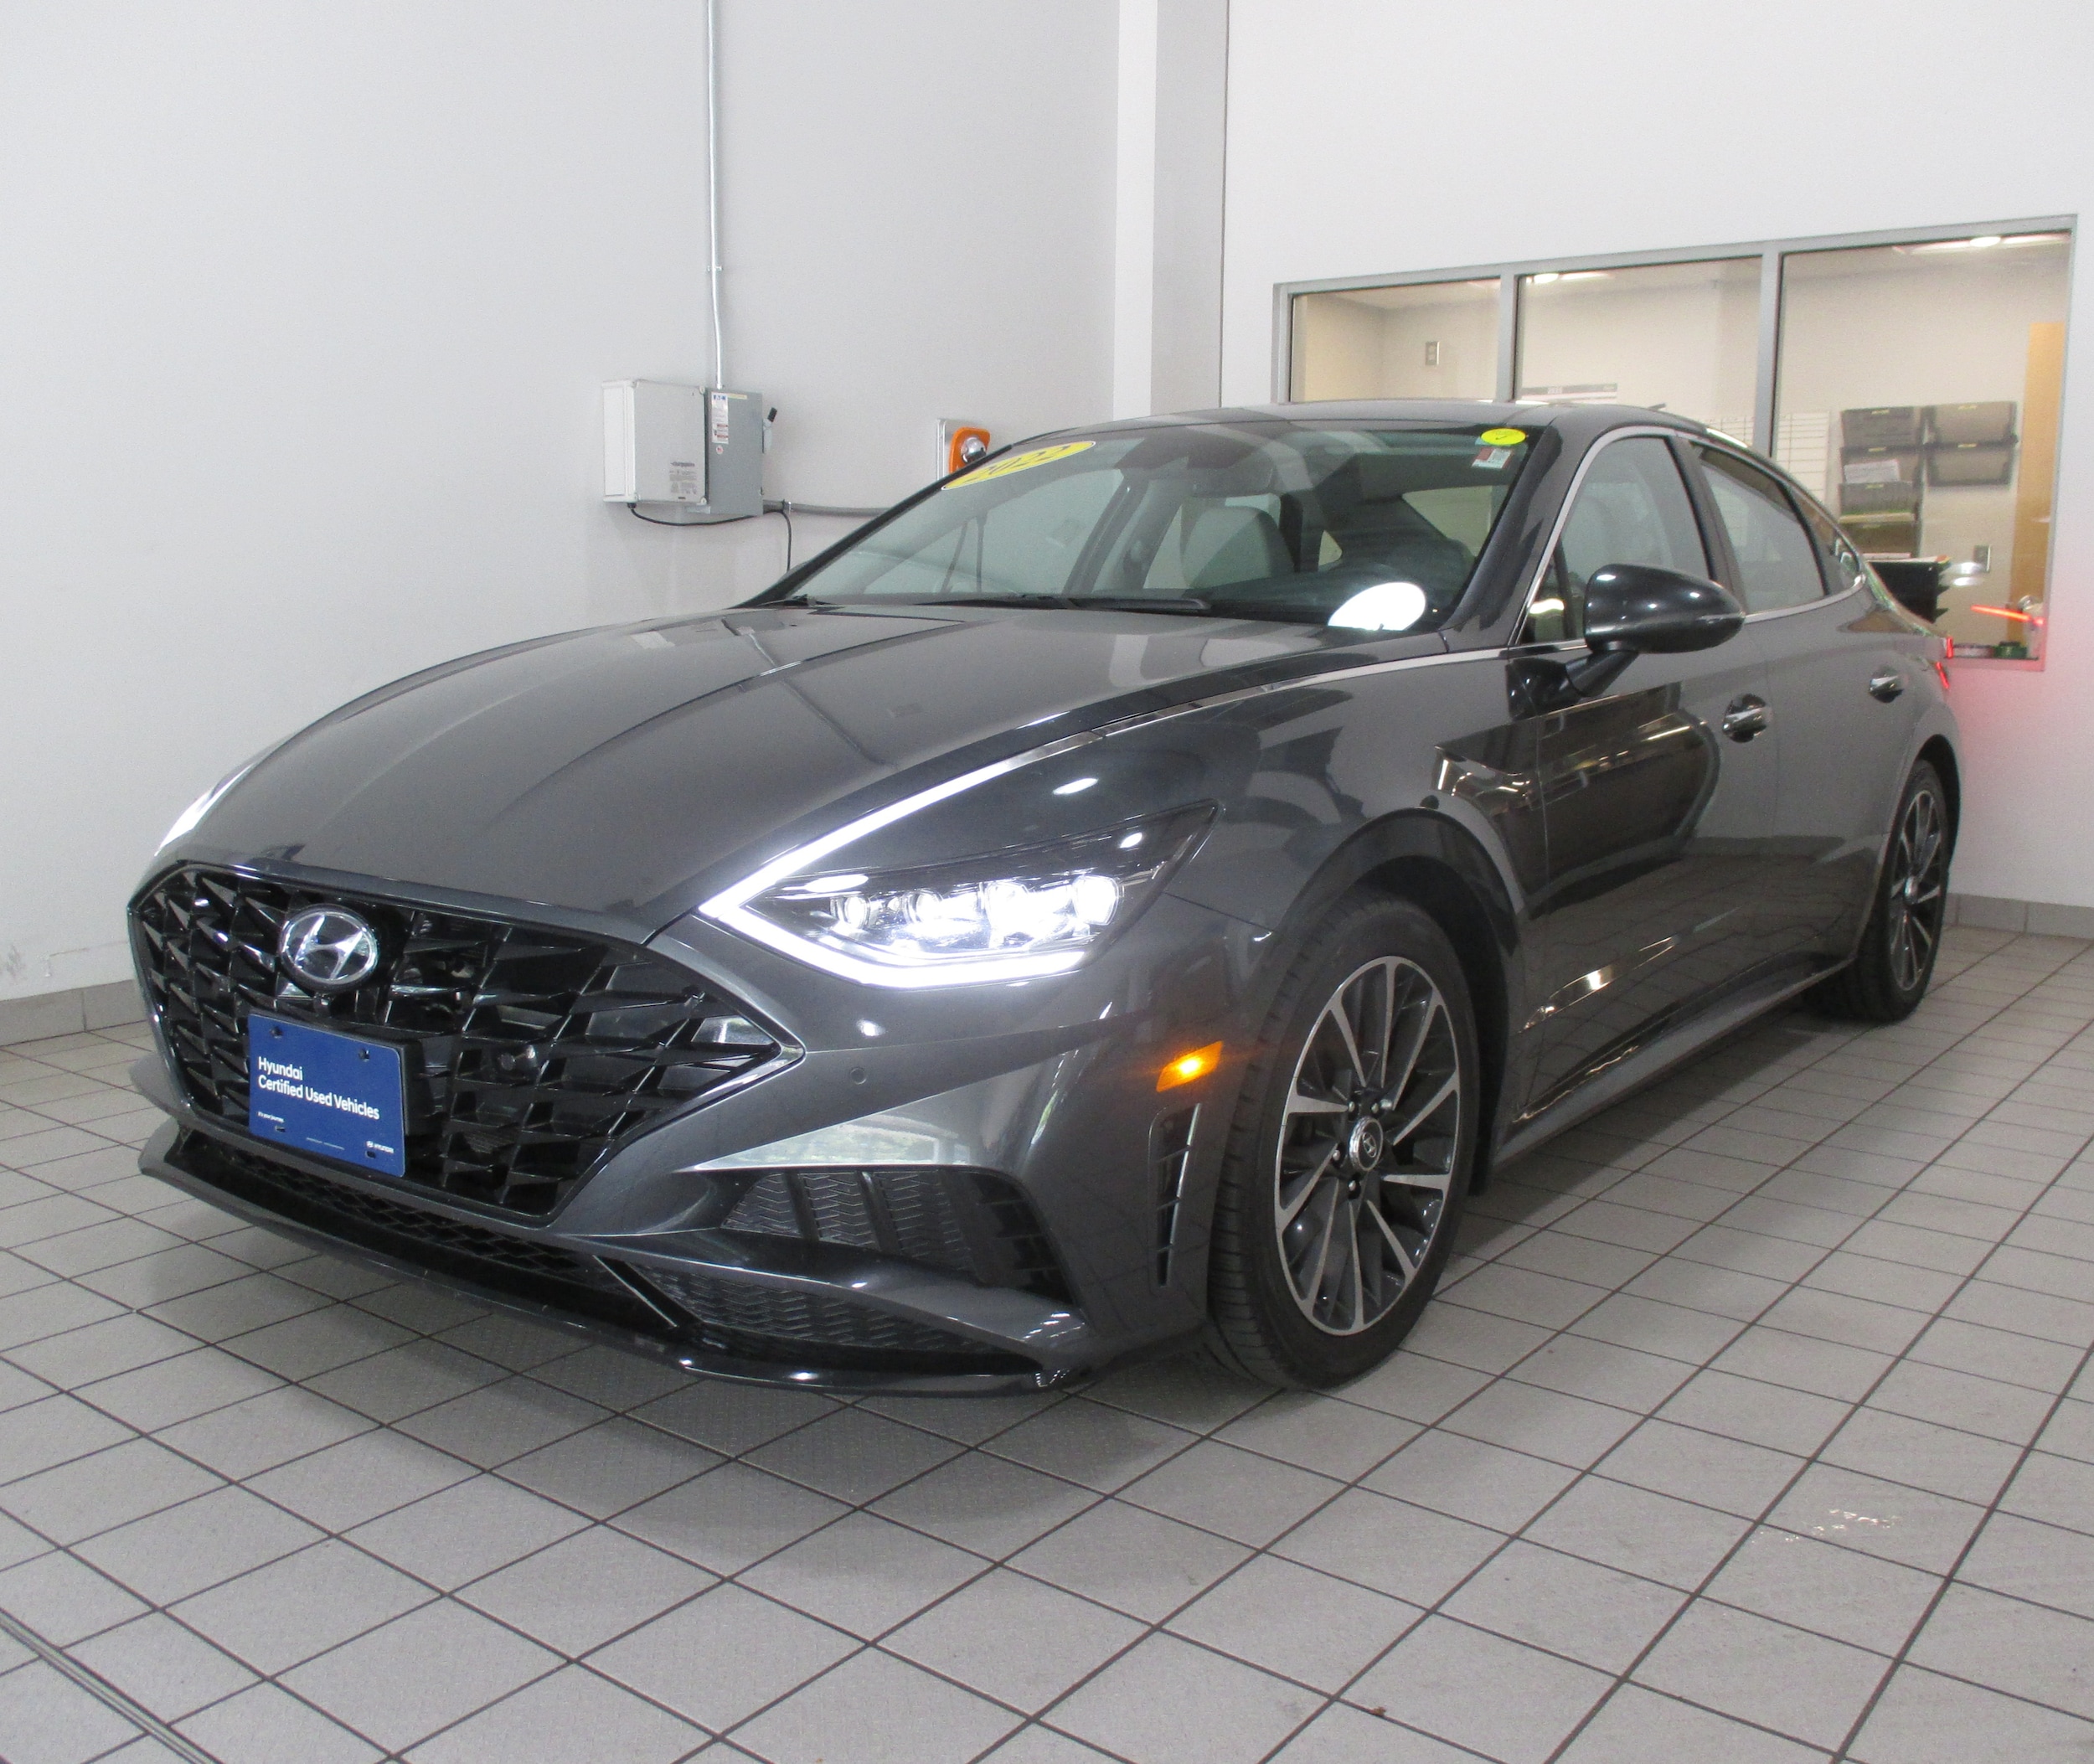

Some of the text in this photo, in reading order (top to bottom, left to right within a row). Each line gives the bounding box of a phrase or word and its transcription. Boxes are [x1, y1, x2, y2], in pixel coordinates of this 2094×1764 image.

[960, 445, 1072, 484] 2022
[258, 1056, 303, 1081] Hyundai
[258, 1075, 380, 1120] Certified Used Vehicles
